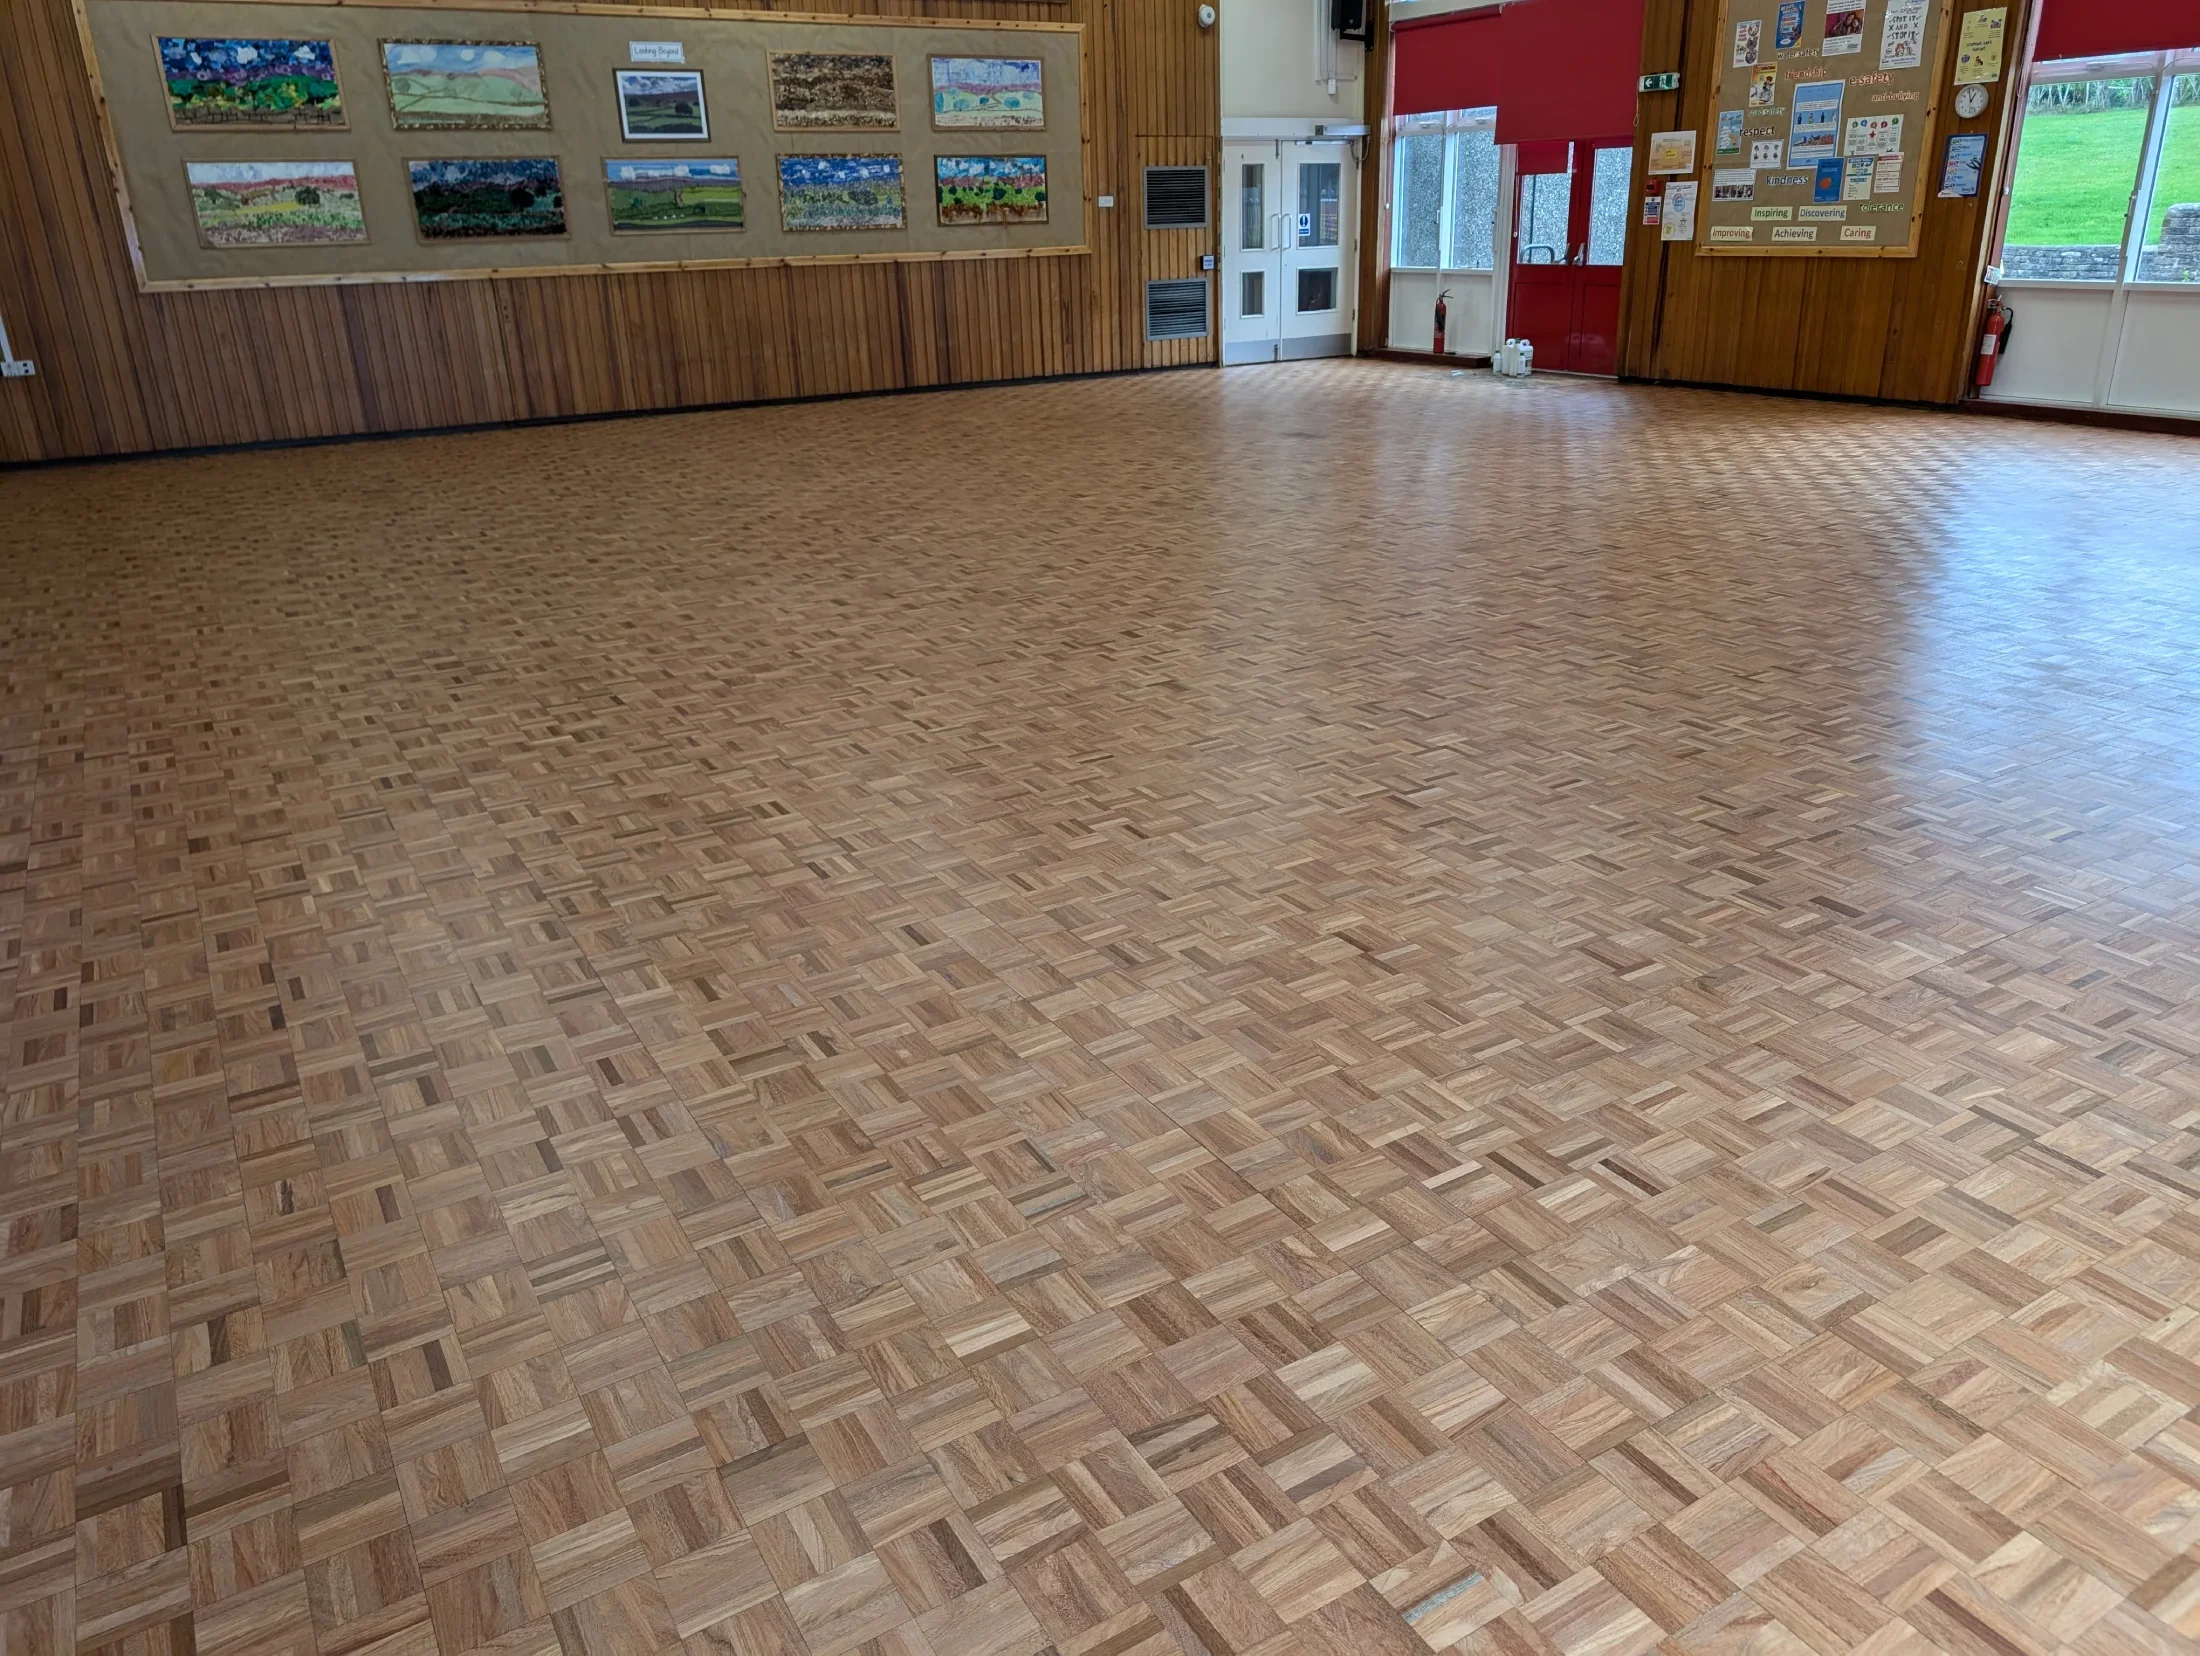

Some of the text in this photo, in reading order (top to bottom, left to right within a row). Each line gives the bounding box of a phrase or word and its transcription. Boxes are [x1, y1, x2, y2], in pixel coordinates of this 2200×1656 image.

[633, 46, 680, 58] Looking Beyond
[1798, 48, 1820, 58] safety
[1785, 67, 1828, 80] friendship
[1849, 70, 1895, 86] e-safety
[1871, 90, 1920, 102] anti-bullying
[1739, 125, 1776, 138] respect
[1766, 174, 1809, 186] kindness
[1859, 201, 1904, 213] tolerance
[1754, 208, 1789, 219] Inspiring
[1799, 208, 1845, 219] Discovering
[1712, 228, 1750, 239] Improving
[1773, 228, 1814, 240] Achieving
[1844, 227, 1872, 239] Caring
